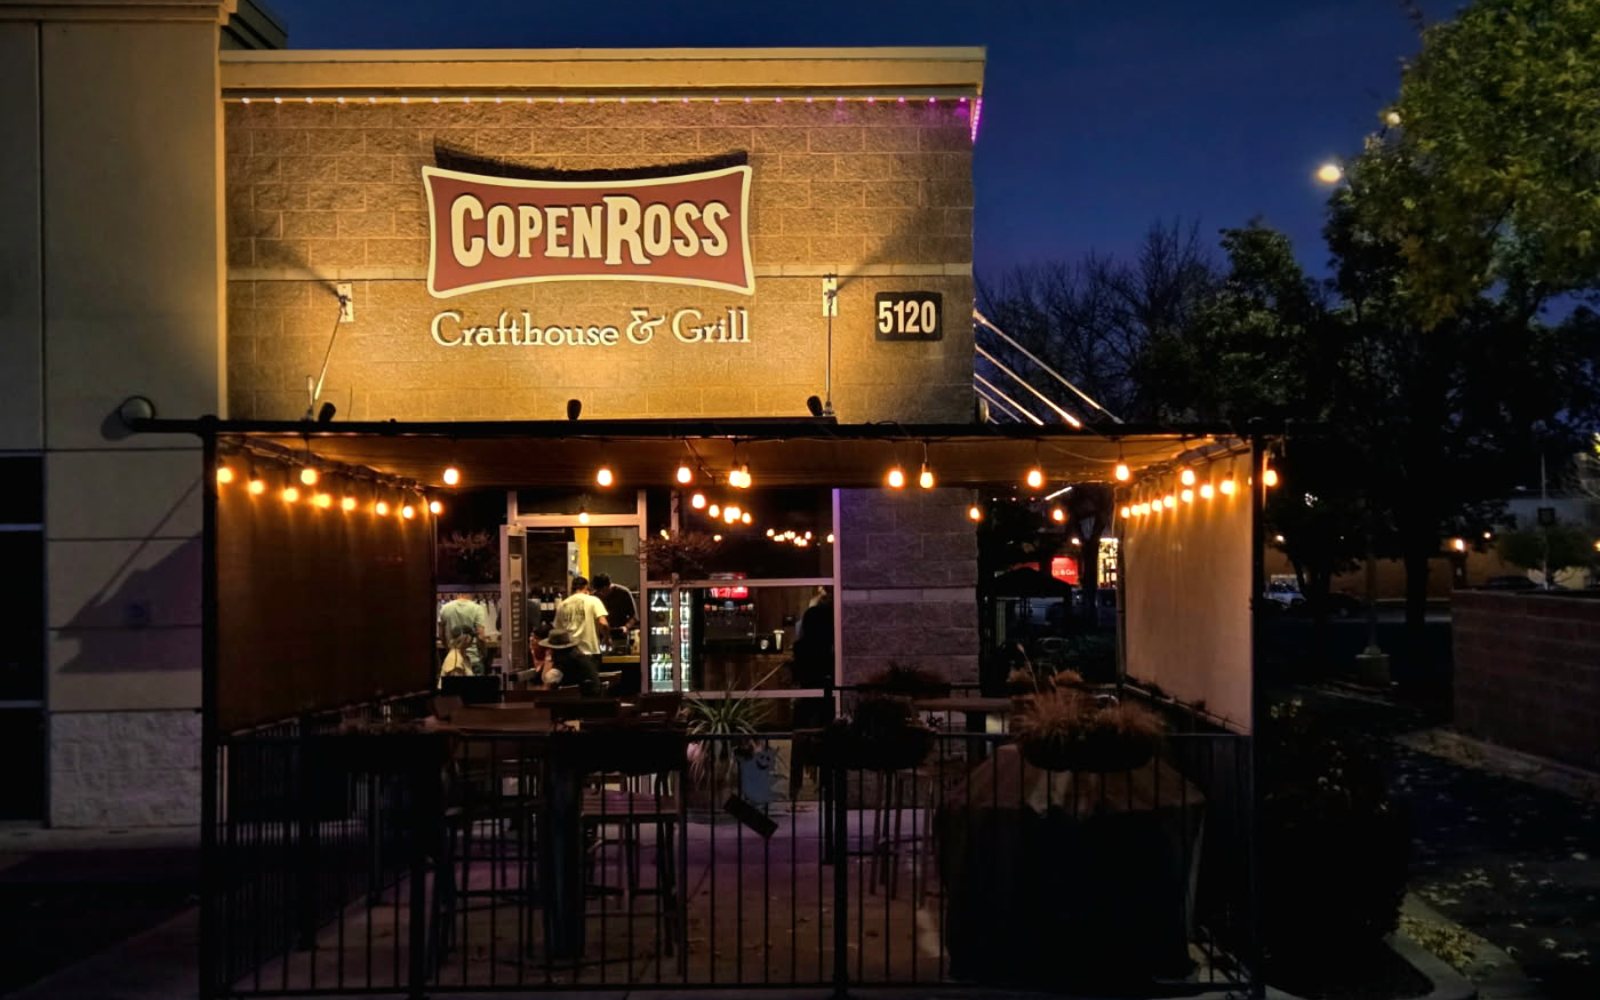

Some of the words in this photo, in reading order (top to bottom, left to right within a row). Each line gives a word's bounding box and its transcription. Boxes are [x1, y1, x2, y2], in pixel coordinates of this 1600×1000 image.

[430, 310, 619, 347] Crafthouse
[626, 309, 666, 345] &
[672, 309, 750, 345] Grill
[878, 300, 936, 334] 5120
